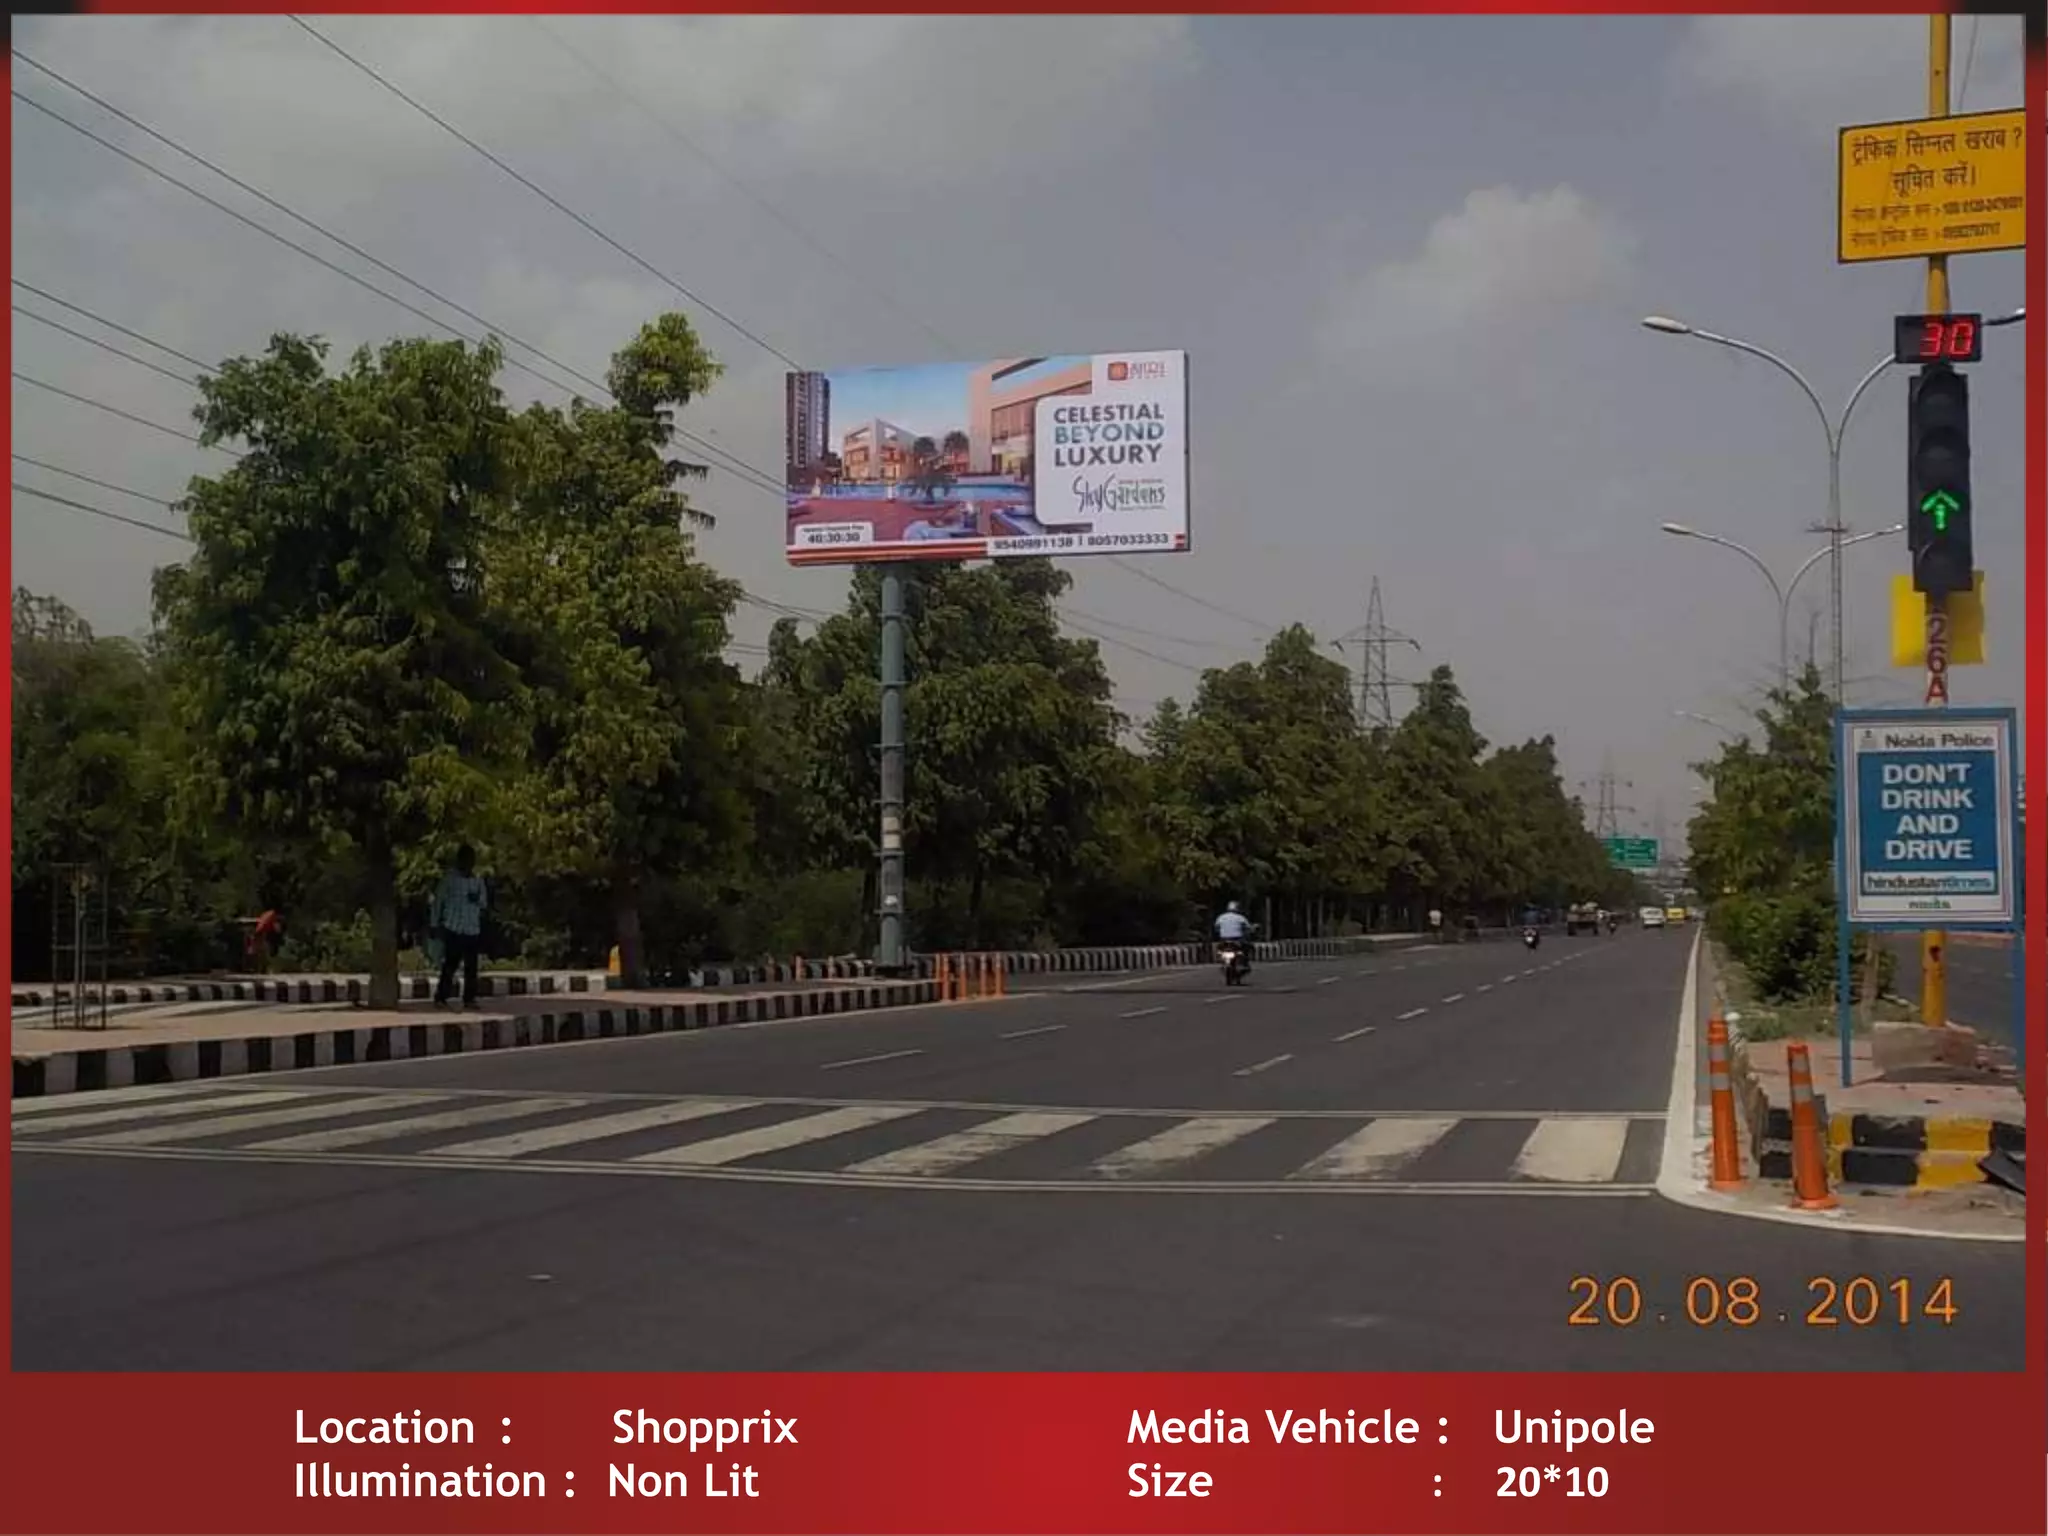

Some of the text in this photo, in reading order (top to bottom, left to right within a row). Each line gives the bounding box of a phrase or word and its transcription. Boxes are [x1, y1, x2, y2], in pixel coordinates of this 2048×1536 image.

[2012, 127, 2022, 149] ?
[1920, 322, 1974, 357] 30
[1053, 403, 1164, 424] CELESTIAL
[1054, 422, 1165, 445] BEYOND
[1054, 444, 1163, 467] LUXURY
[1926, 616, 1949, 705] 26A
[1884, 732, 1995, 749] Noida Police
[1882, 763, 1972, 784] DON'T
[1881, 788, 1974, 809] DRINK
[1896, 814, 1960, 835] AND
[1885, 839, 1973, 860] DRIVE
